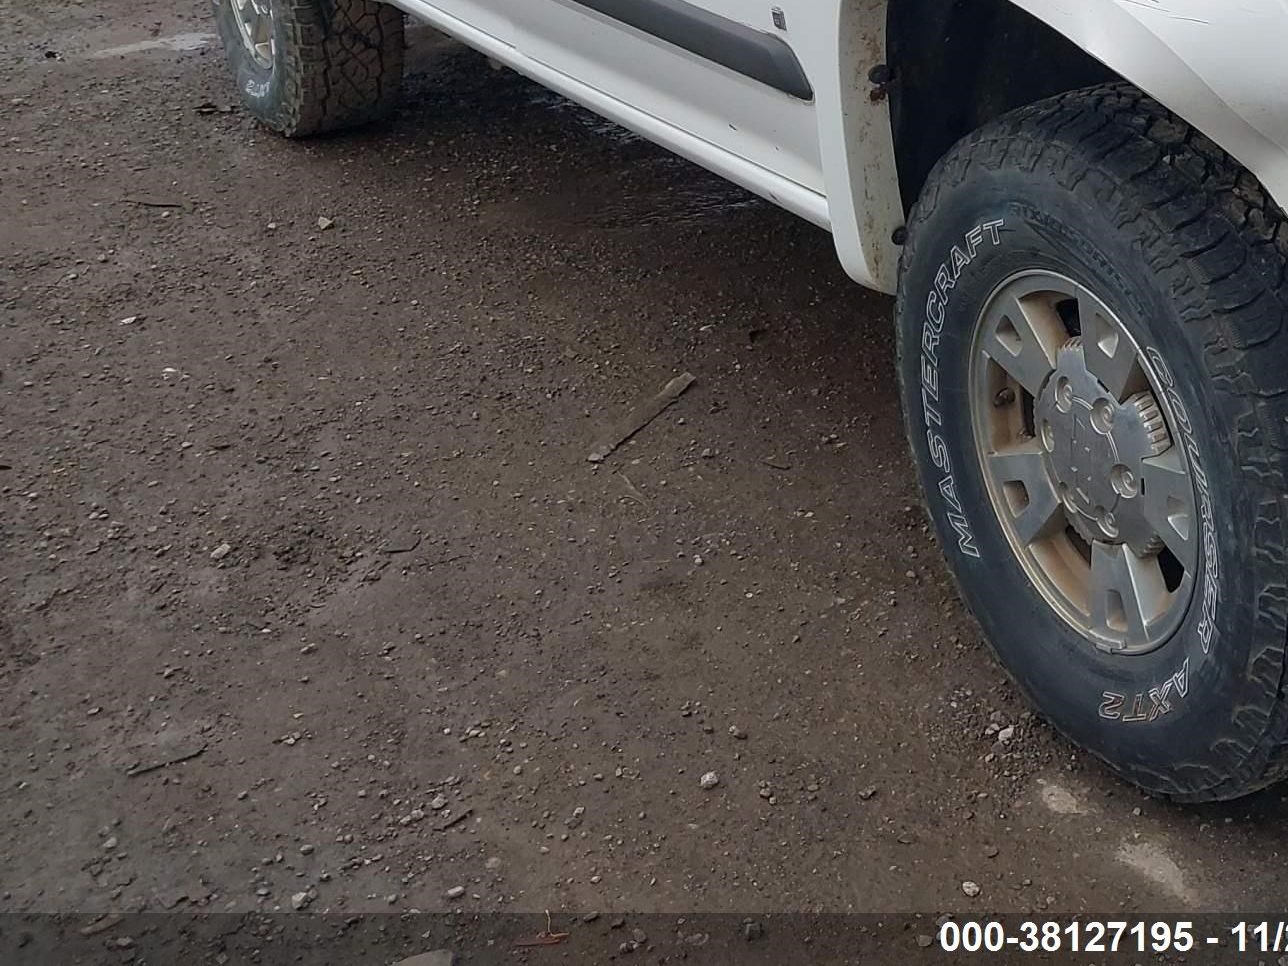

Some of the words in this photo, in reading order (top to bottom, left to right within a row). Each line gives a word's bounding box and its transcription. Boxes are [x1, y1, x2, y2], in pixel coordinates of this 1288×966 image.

[921, 218, 1005, 558] MASTERCRAFT
[1146, 345, 1218, 654] COURSER
[1098, 656, 1190, 722] AXT2
